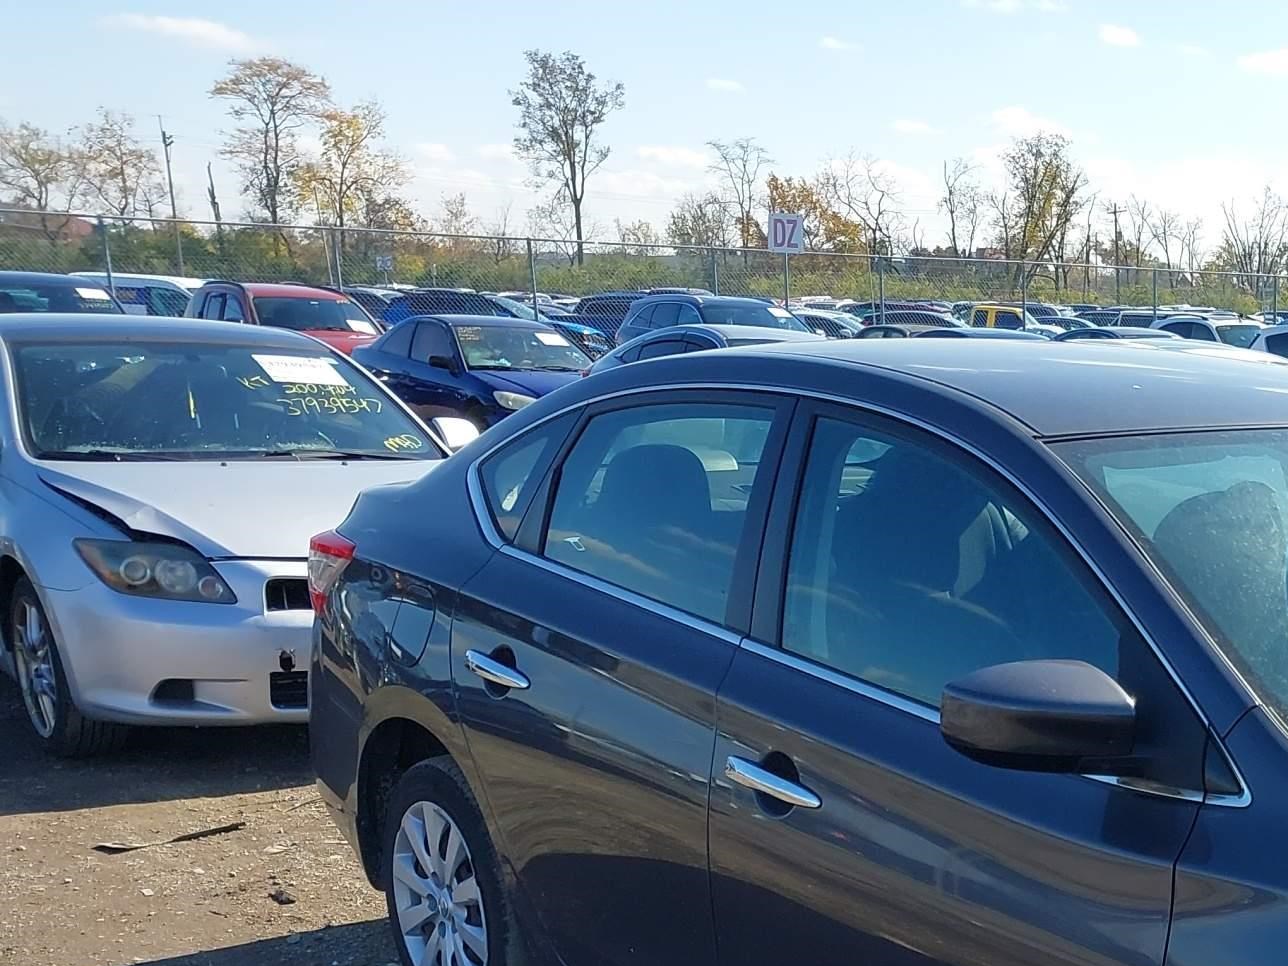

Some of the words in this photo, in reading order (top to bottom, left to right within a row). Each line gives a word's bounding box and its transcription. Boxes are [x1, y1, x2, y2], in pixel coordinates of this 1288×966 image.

[773, 218, 799, 249] DZ
[236, 375, 270, 390] KT
[276, 397, 383, 416] 37939547
